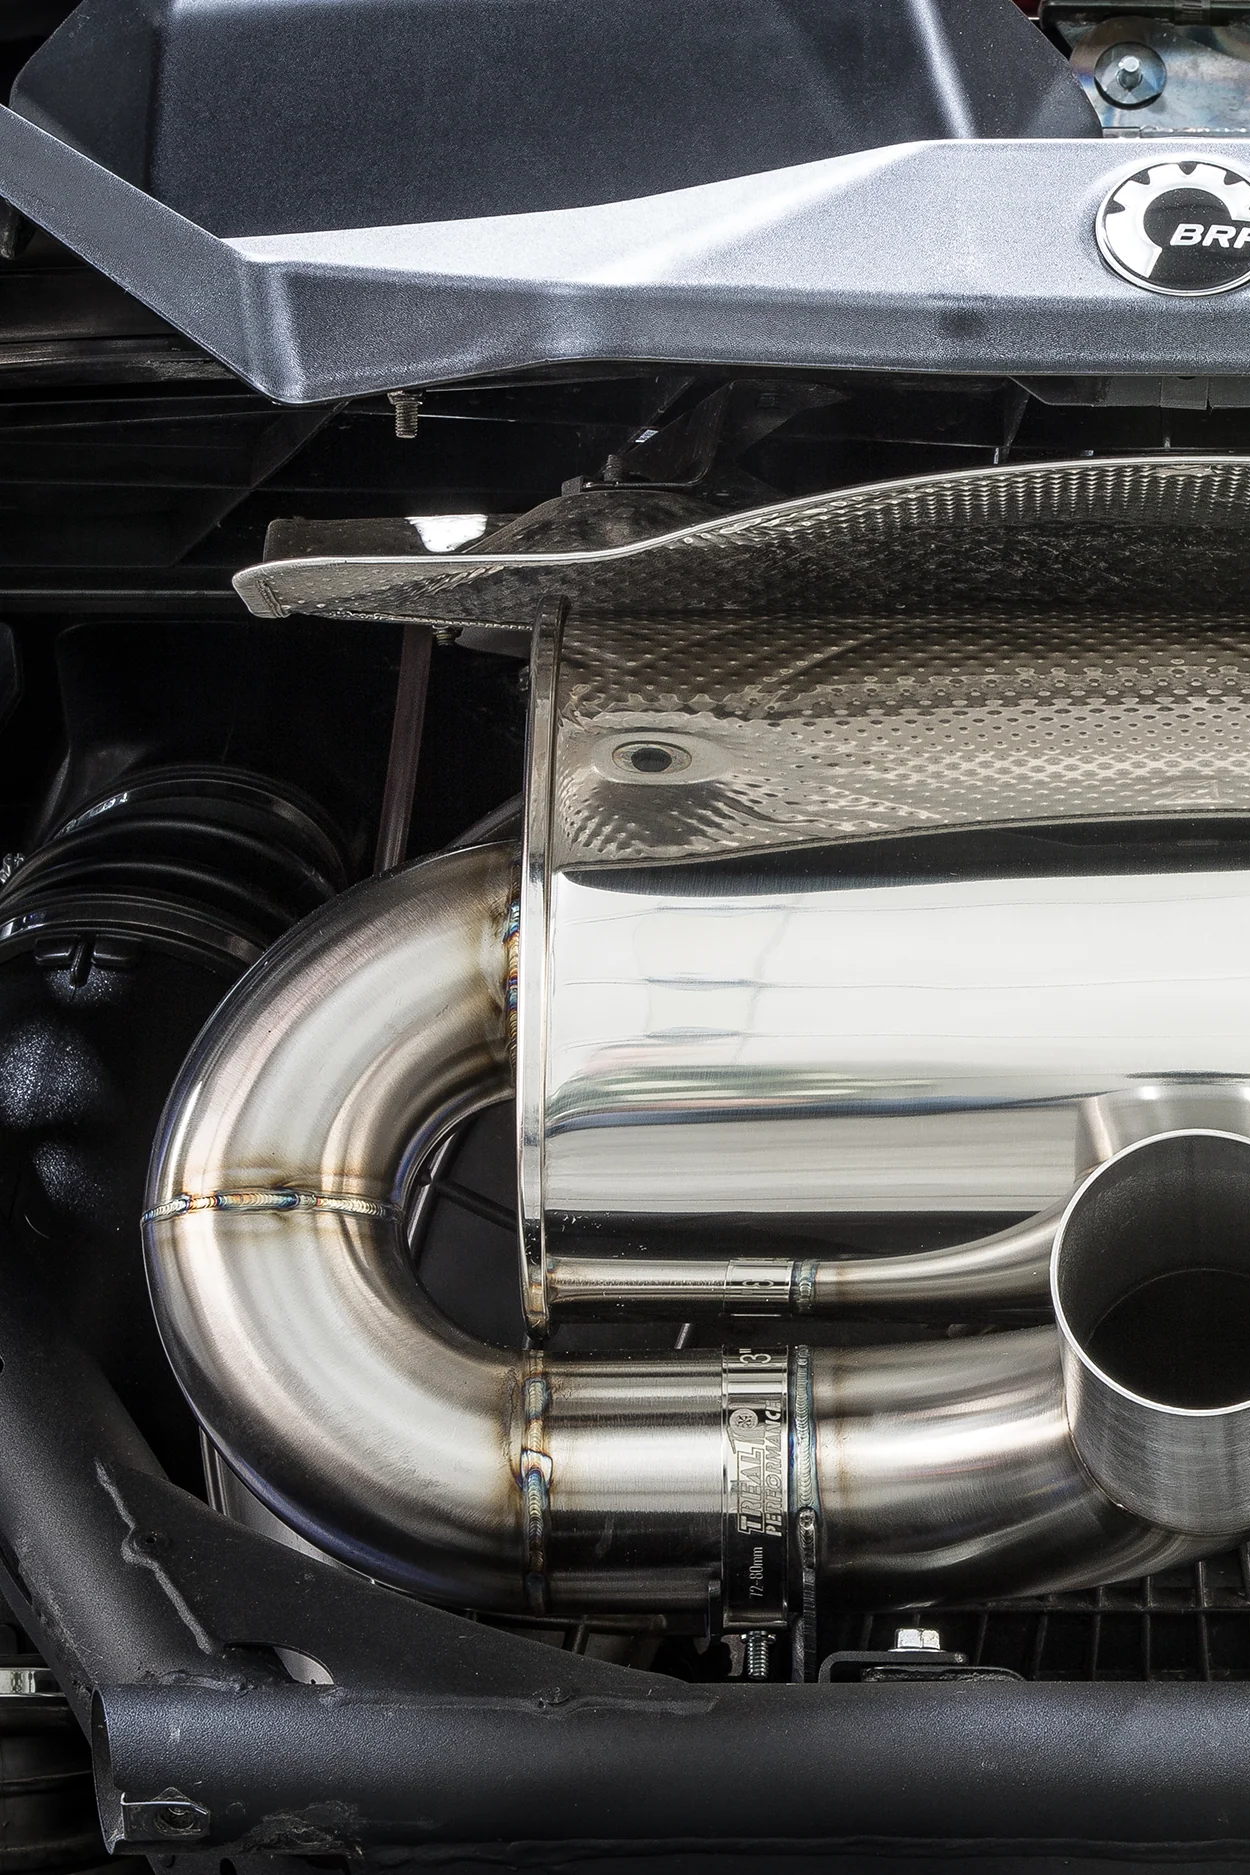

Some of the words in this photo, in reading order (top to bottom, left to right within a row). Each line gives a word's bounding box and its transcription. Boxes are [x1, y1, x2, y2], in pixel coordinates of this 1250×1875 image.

[740, 1449, 761, 1532] TREAL
[765, 1400, 783, 1537] PERFORMANCE
[750, 1546, 764, 1598] 72-80mm
